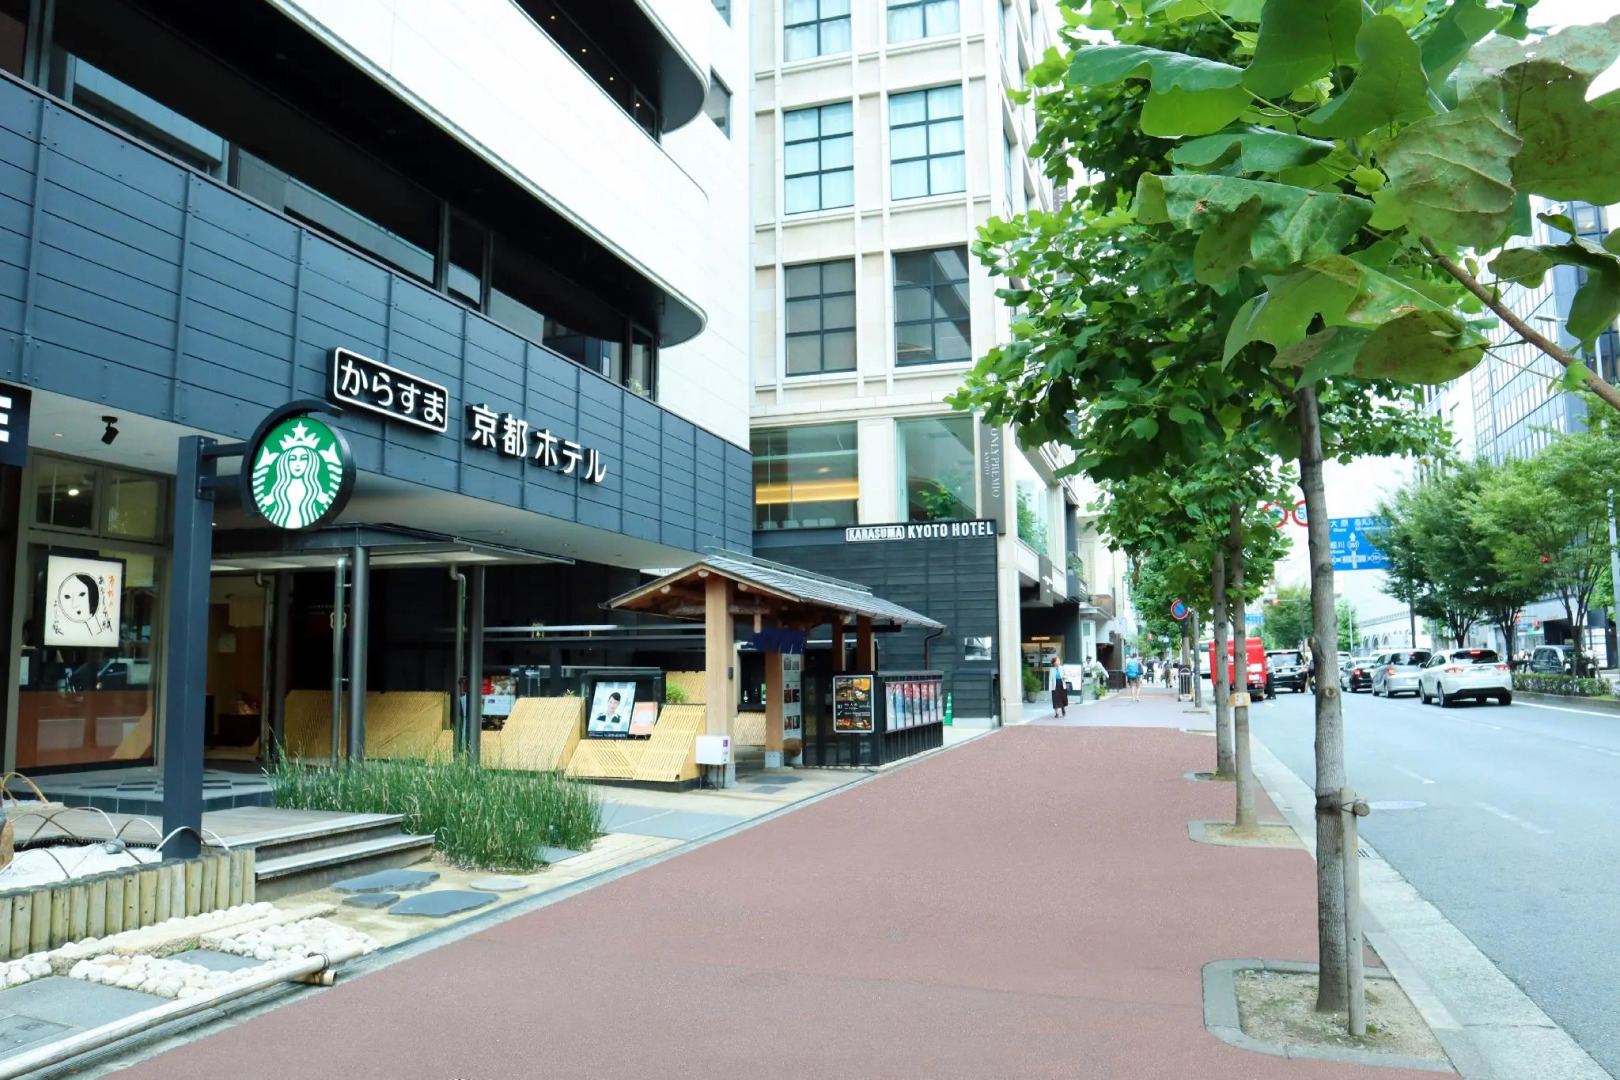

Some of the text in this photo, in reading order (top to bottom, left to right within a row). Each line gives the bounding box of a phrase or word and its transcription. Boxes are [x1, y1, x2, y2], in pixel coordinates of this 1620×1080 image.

[341, 360, 607, 483] からすま 京都ホテル
[990, 427, 1000, 498] ONLY PREMIO
[849, 522, 994, 540] KARASUMA KYOTO HOTEL
